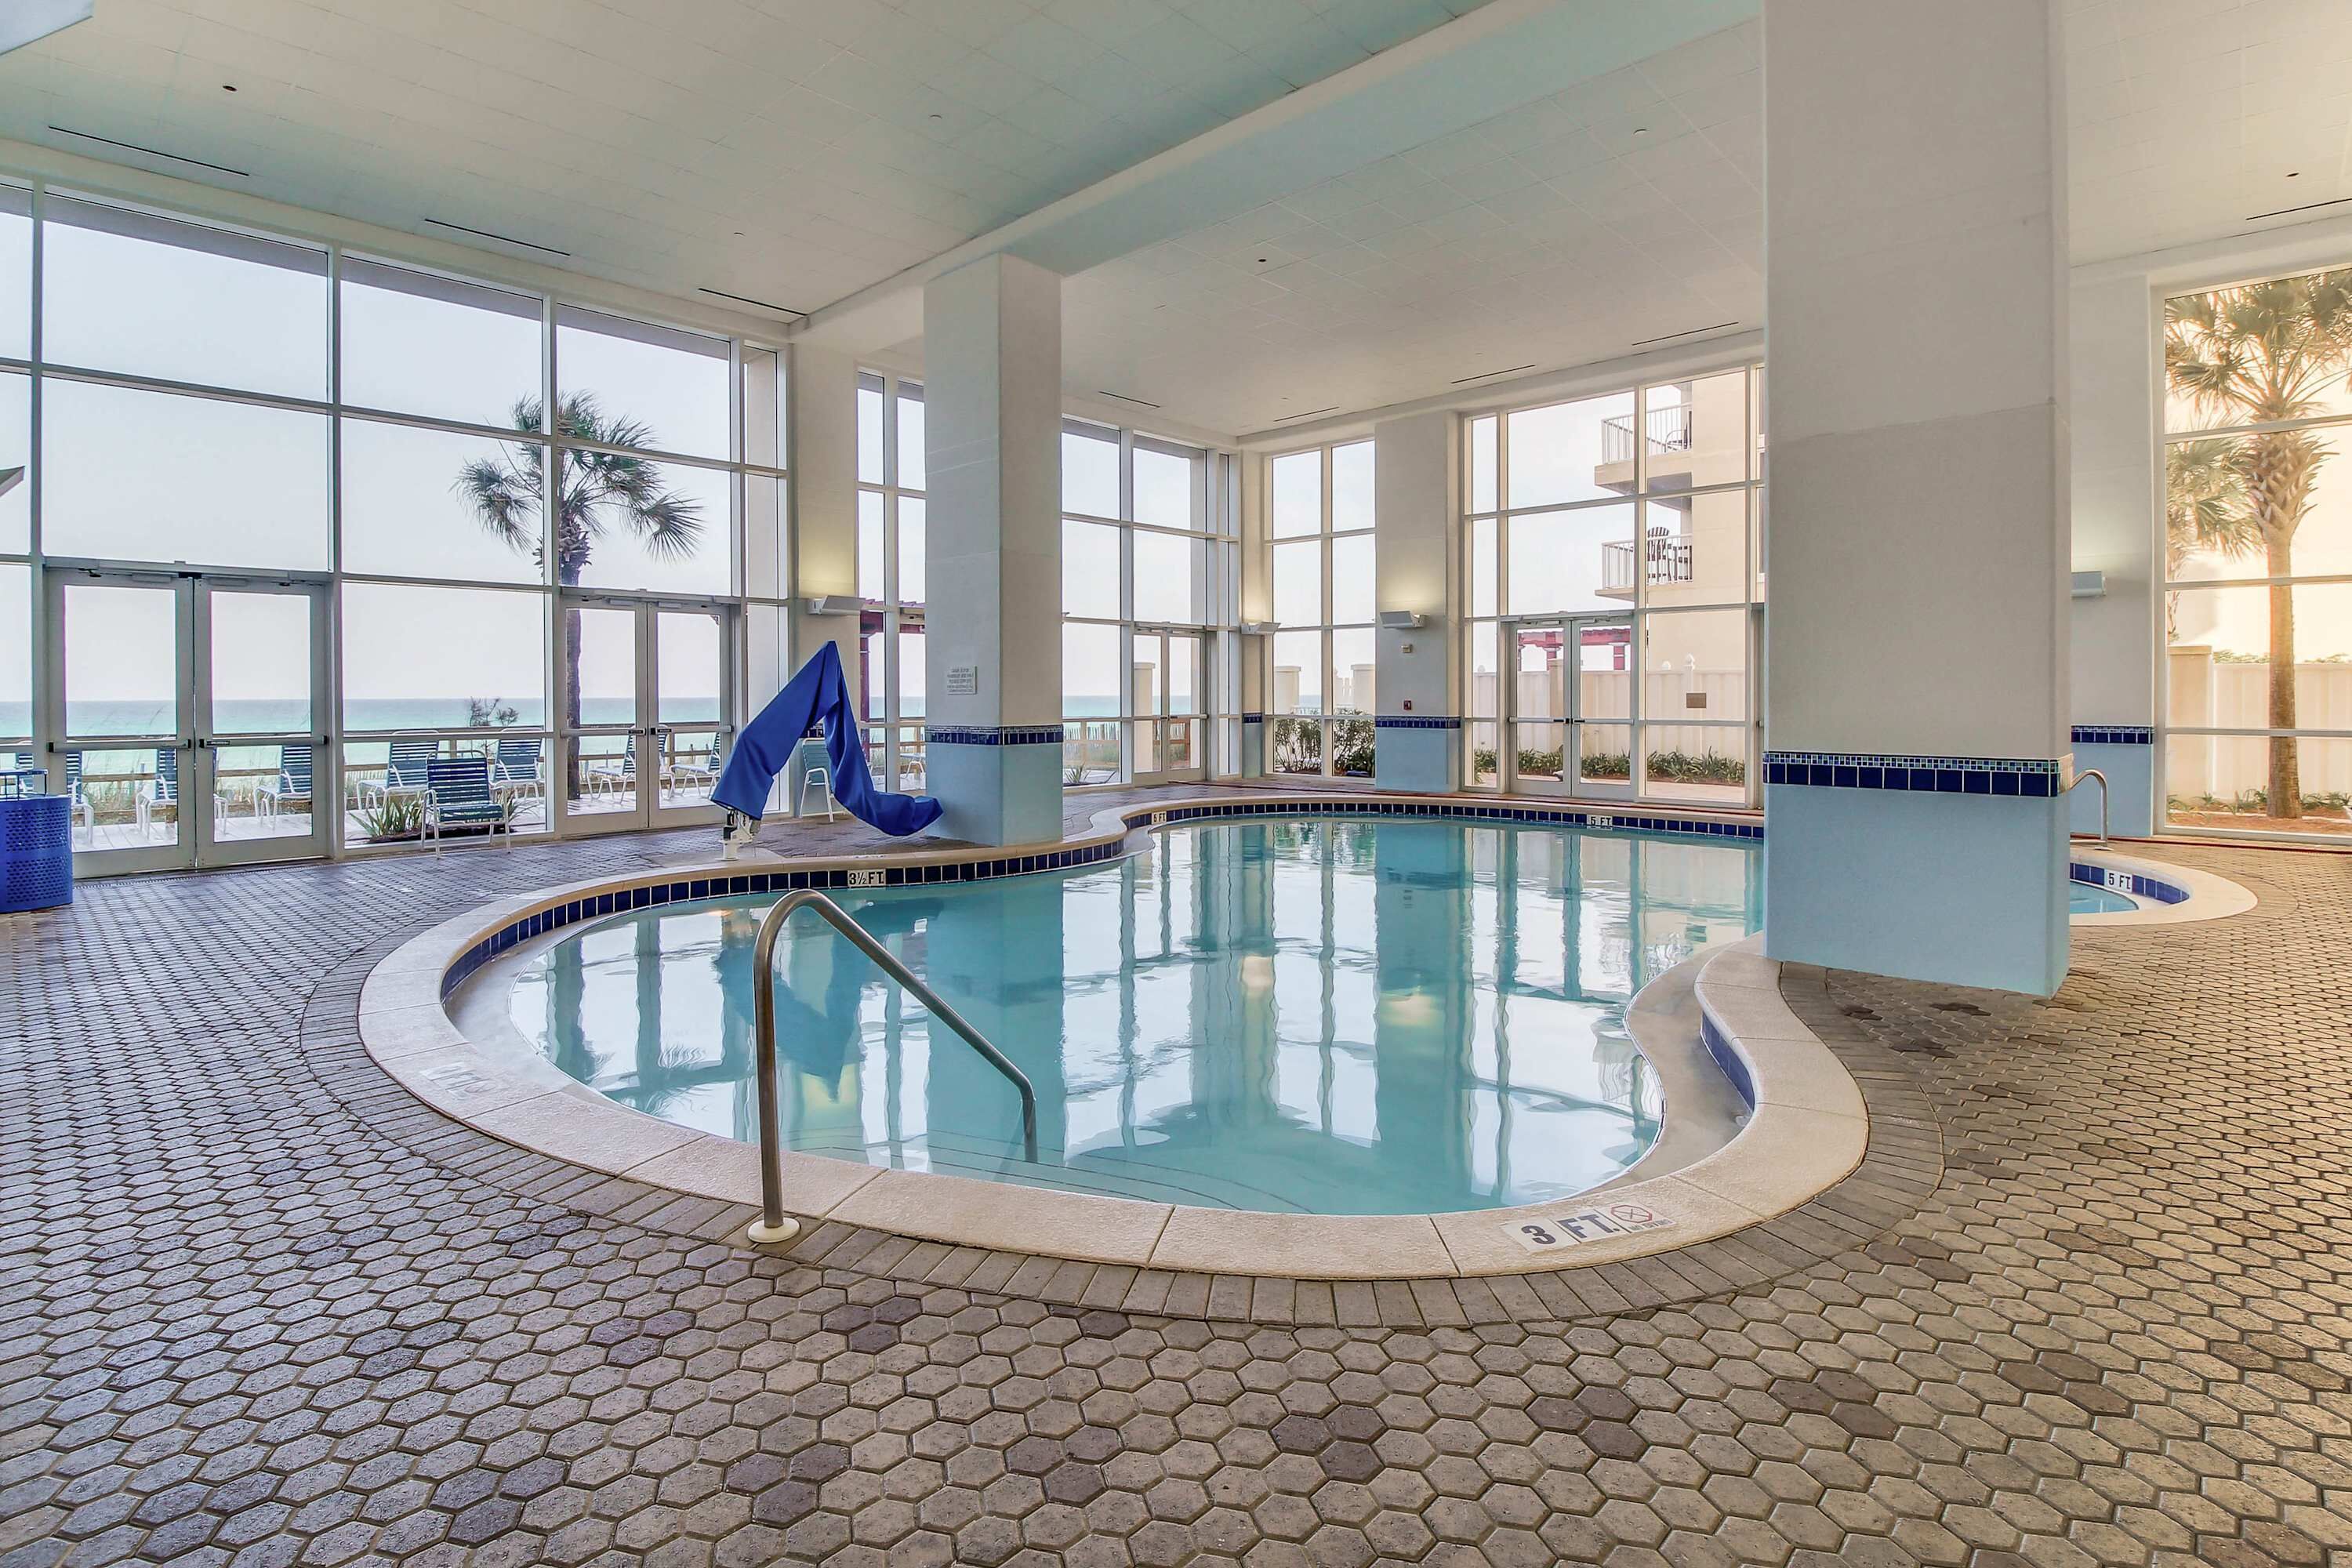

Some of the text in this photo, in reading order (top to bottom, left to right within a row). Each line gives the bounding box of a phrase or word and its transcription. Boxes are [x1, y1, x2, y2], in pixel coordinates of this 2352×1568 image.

[1591, 816, 1595, 826] 5
[2108, 873, 2114, 885] 5
[1521, 1225, 1556, 1245] 3
[1557, 1214, 1620, 1239] FT.
